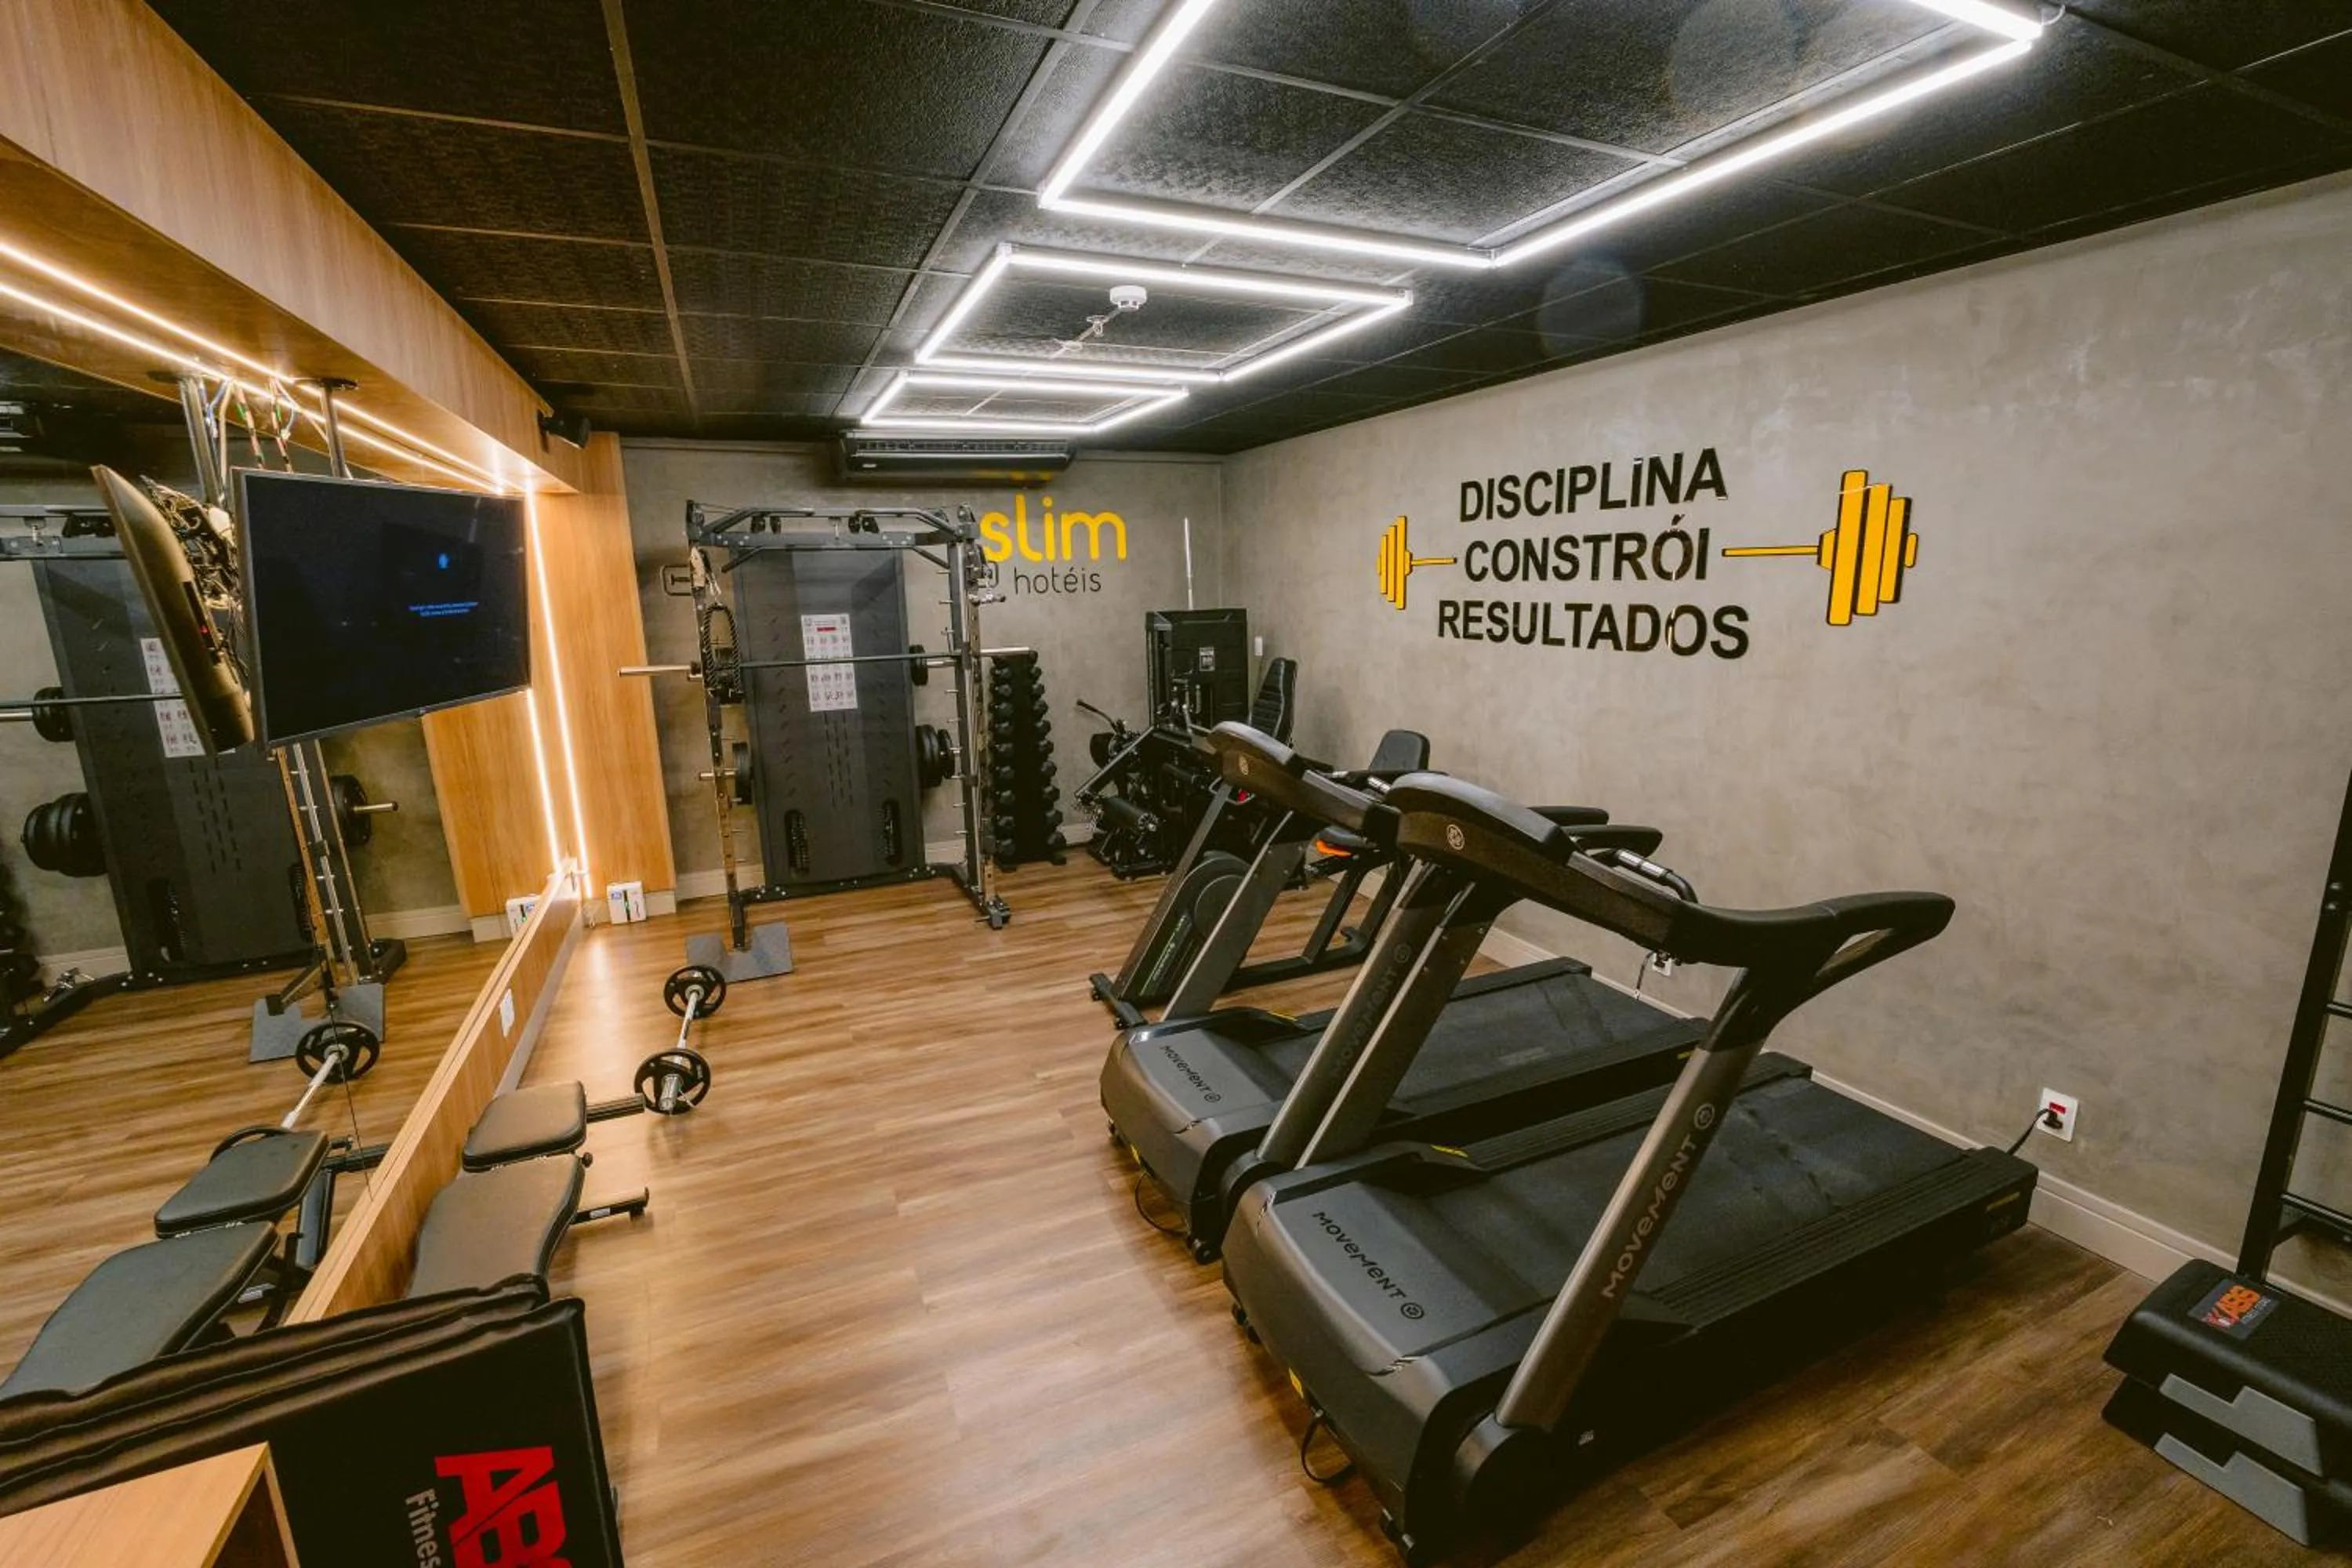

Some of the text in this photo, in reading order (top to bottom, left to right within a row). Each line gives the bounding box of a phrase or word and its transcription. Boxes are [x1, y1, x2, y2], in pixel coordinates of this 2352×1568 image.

[1460, 448, 1728, 523] DISCIPLINA
[980, 494, 1127, 562] slim
[1465, 514, 1711, 583] CONSTRÓI
[1013, 566, 1102, 595] hotéis
[1437, 600, 1750, 659] RESULTADOS
[434, 1445, 573, 1568] AB
